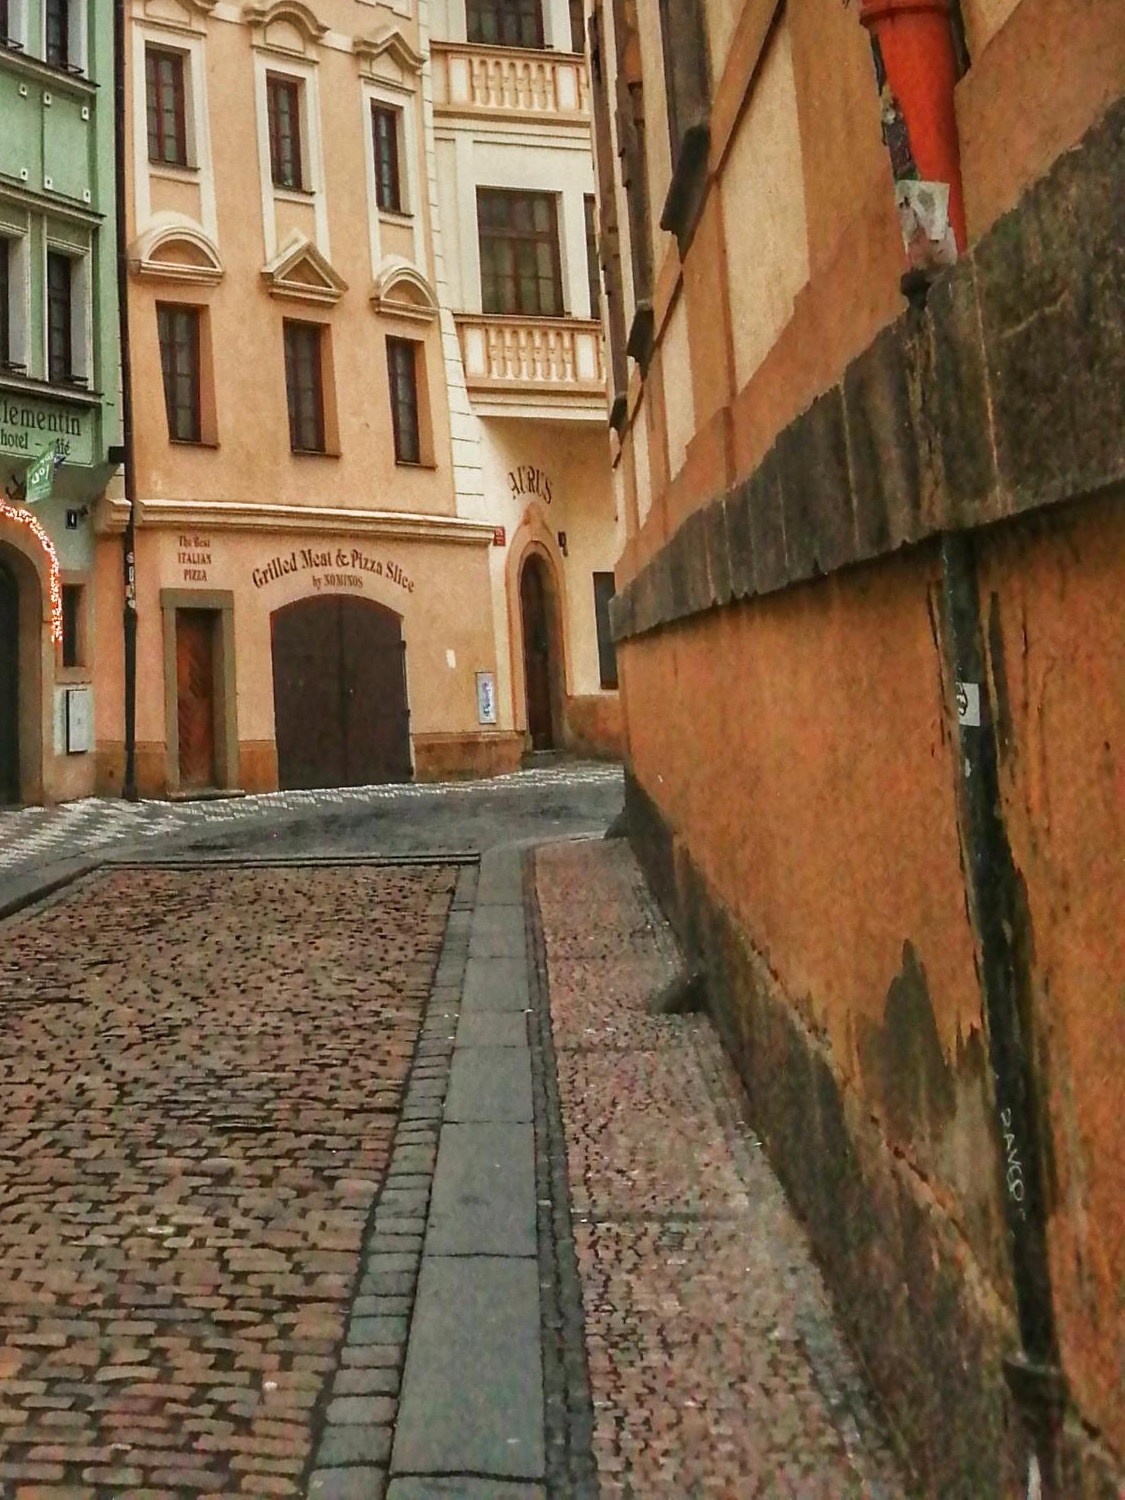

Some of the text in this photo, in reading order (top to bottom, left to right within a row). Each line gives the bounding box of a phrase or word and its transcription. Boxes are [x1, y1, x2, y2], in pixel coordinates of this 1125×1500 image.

[0, 428, 28, 450] hotel
[508, 465, 553, 504] AURUS
[179, 535, 210, 548] The Best
[178, 552, 212, 564] ITALIAN
[183, 568, 208, 582] PIZZA
[252, 548, 415, 593] Grilled Meat & Pizza Slice
[312, 574, 363, 591] by NOMINOS
